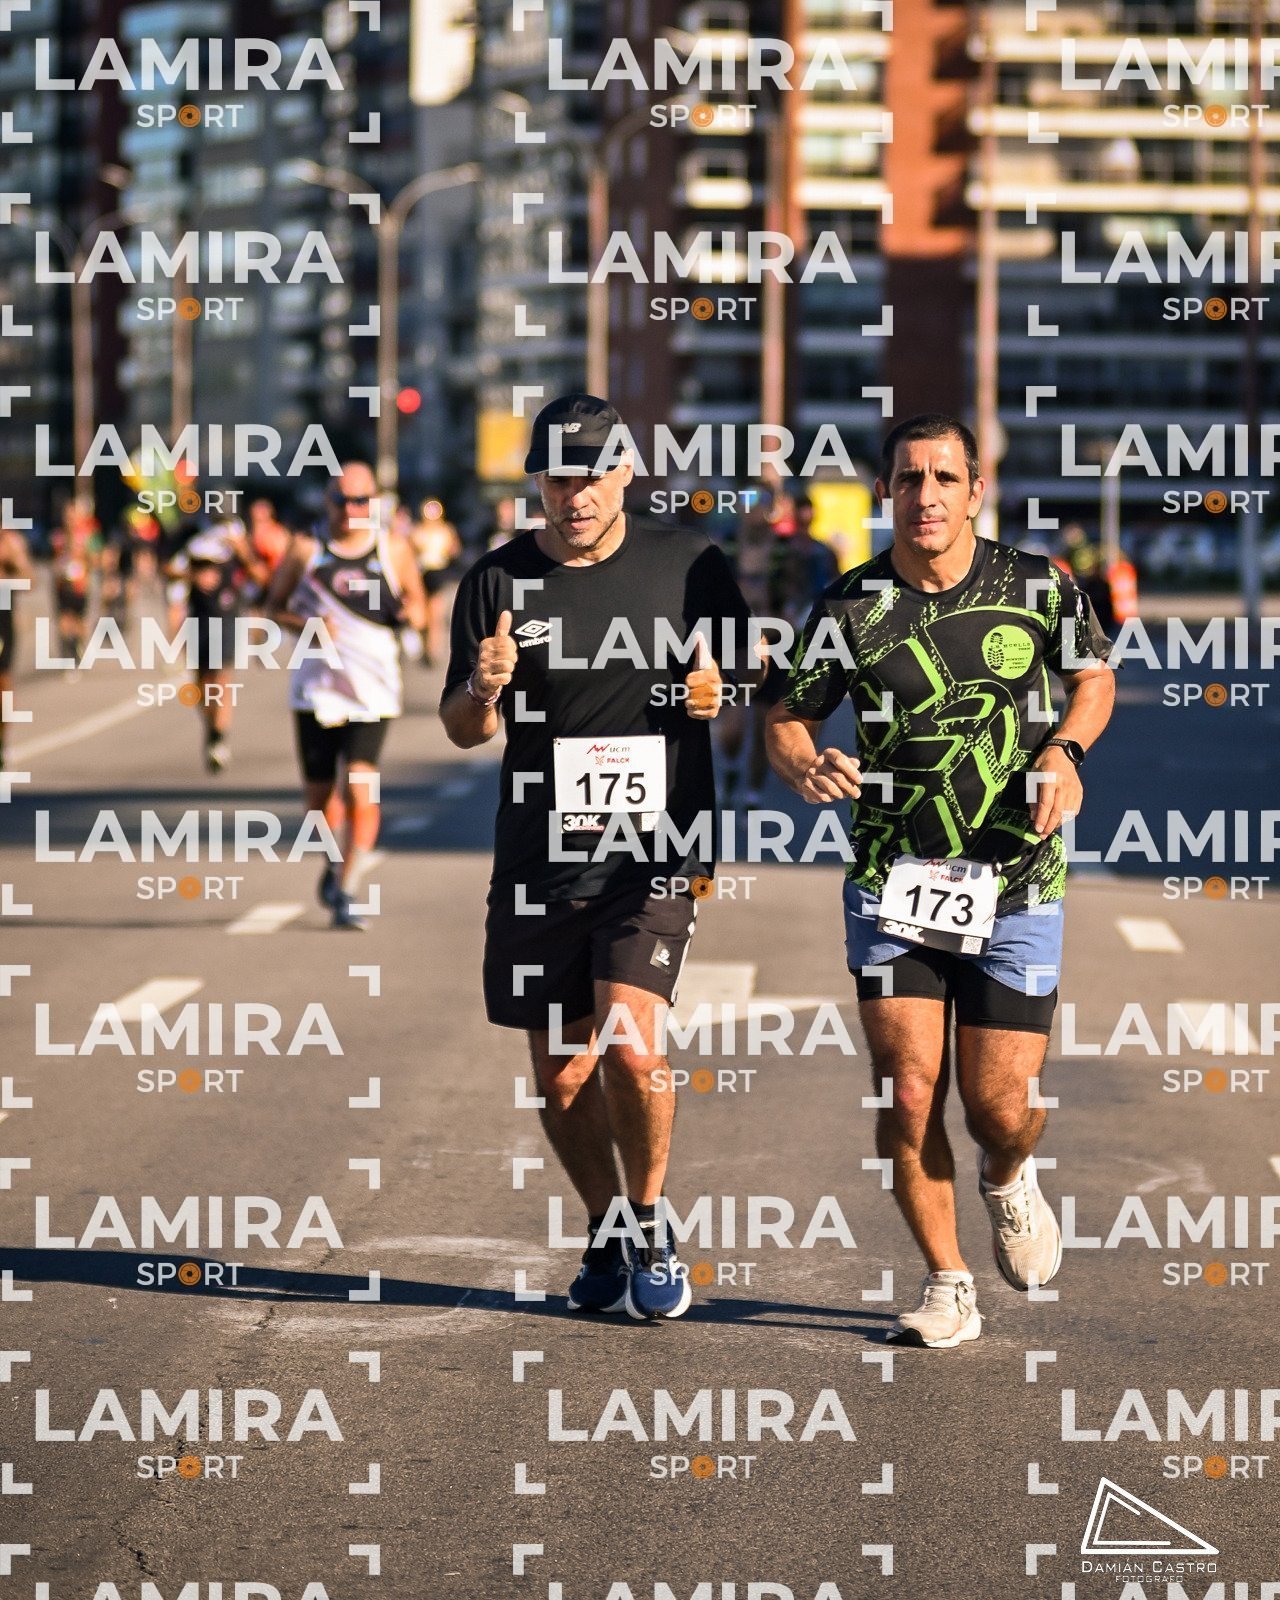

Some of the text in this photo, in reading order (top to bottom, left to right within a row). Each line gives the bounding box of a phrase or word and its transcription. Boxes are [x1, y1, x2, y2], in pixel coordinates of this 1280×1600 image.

[518, 635, 553, 649] umbro
[575, 772, 647, 806] 175
[562, 814, 602, 832] 30K
[905, 884, 974, 927] 173
[882, 920, 924, 939] 30K
